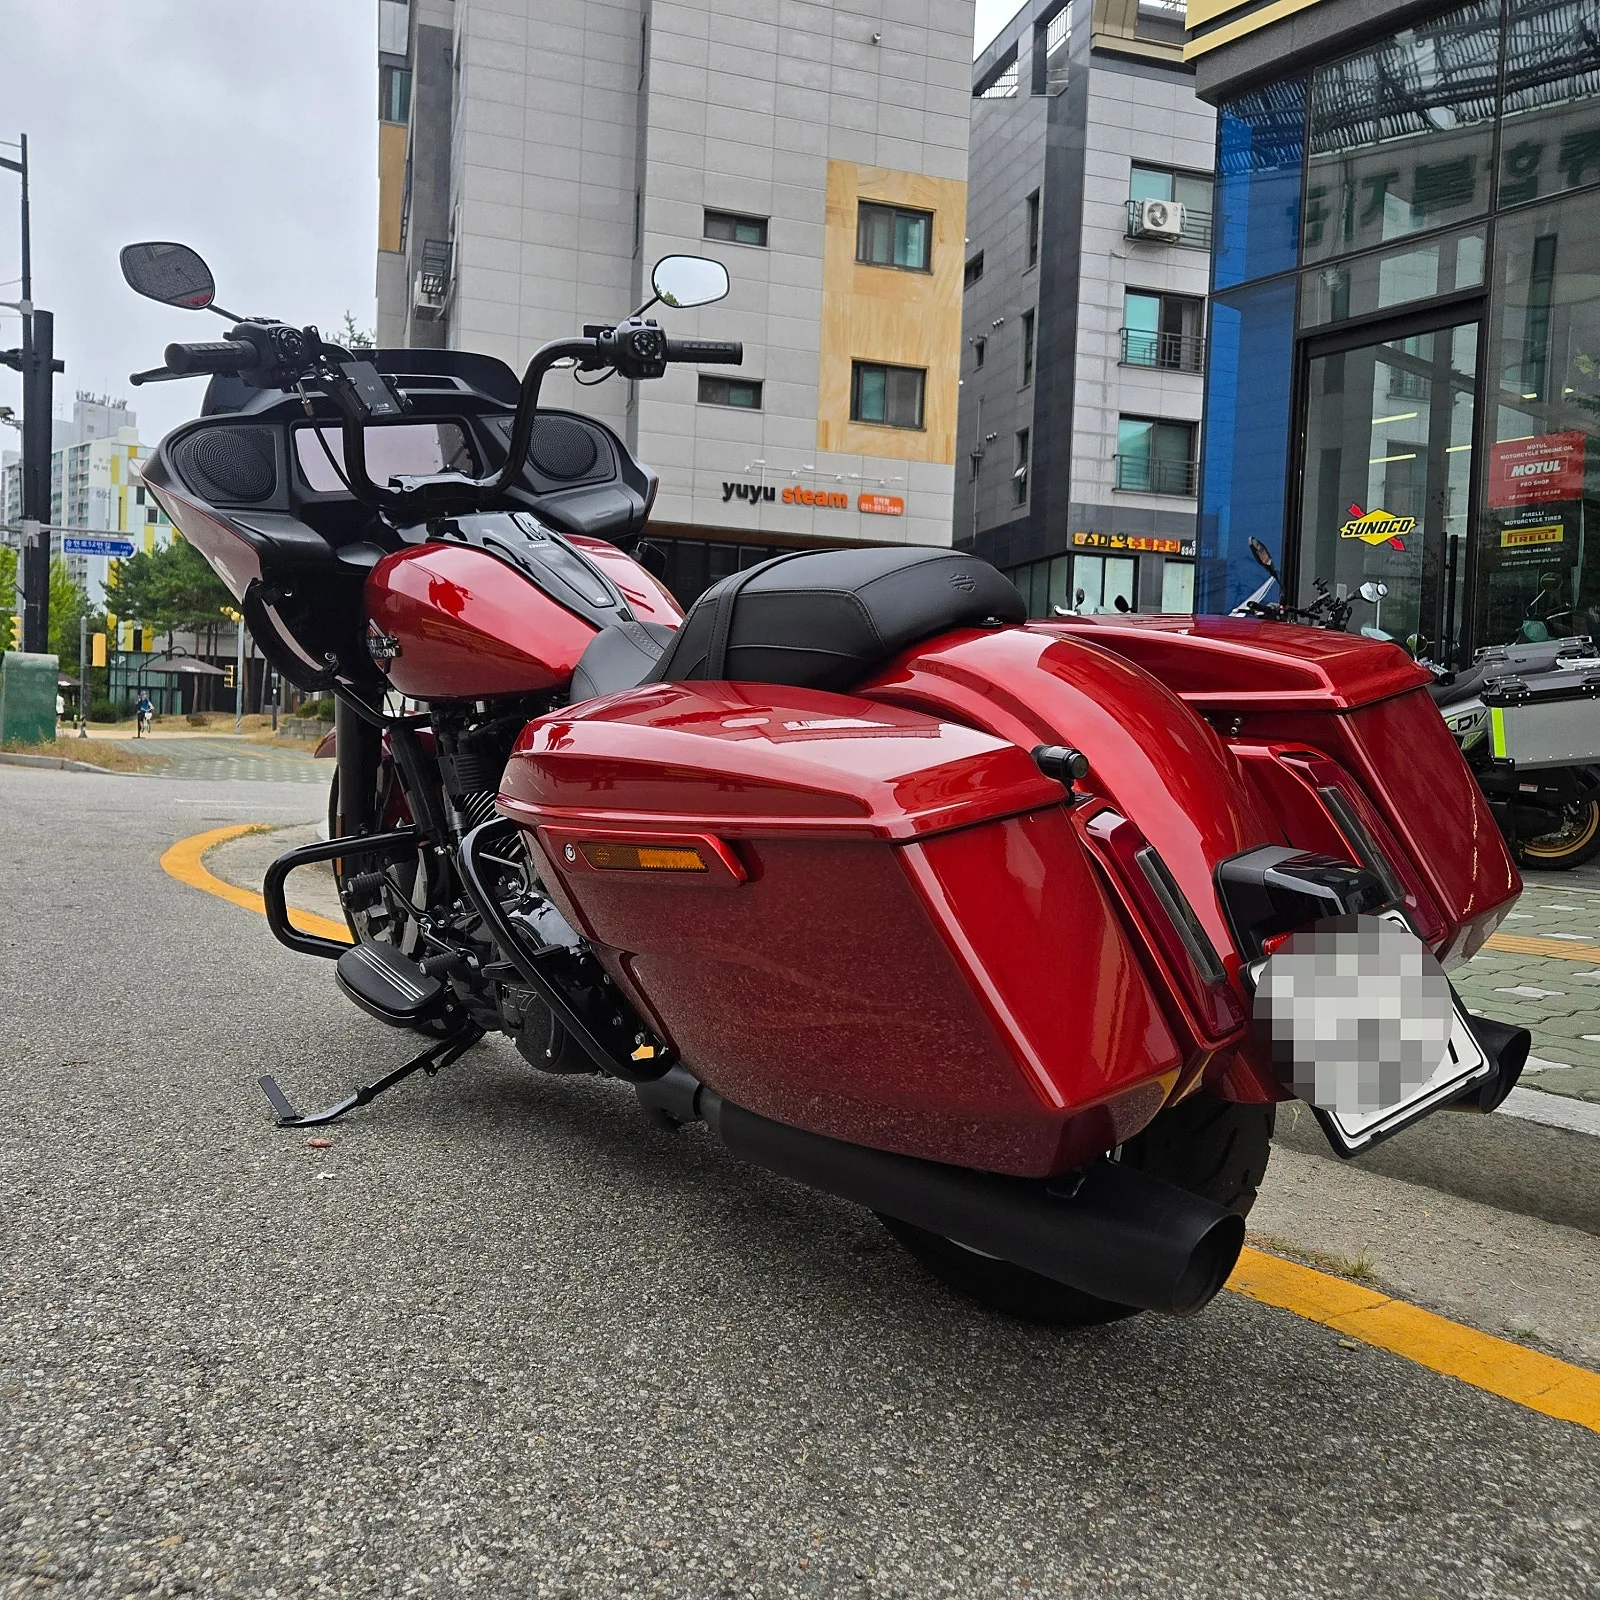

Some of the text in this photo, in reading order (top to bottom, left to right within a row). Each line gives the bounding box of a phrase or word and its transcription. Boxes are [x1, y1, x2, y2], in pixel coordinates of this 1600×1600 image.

[1500, 449, 1539, 460] MOTORCYCLE
[1540, 446, 1562, 454] ENGINE
[1511, 460, 1561, 477] MOTUL
[722, 482, 848, 509] yuyu steam
[1343, 519, 1413, 536] SUNOCO
[1504, 518, 1543, 526] MOTORCYCLE
[1507, 528, 1557, 544] PIRELLI
